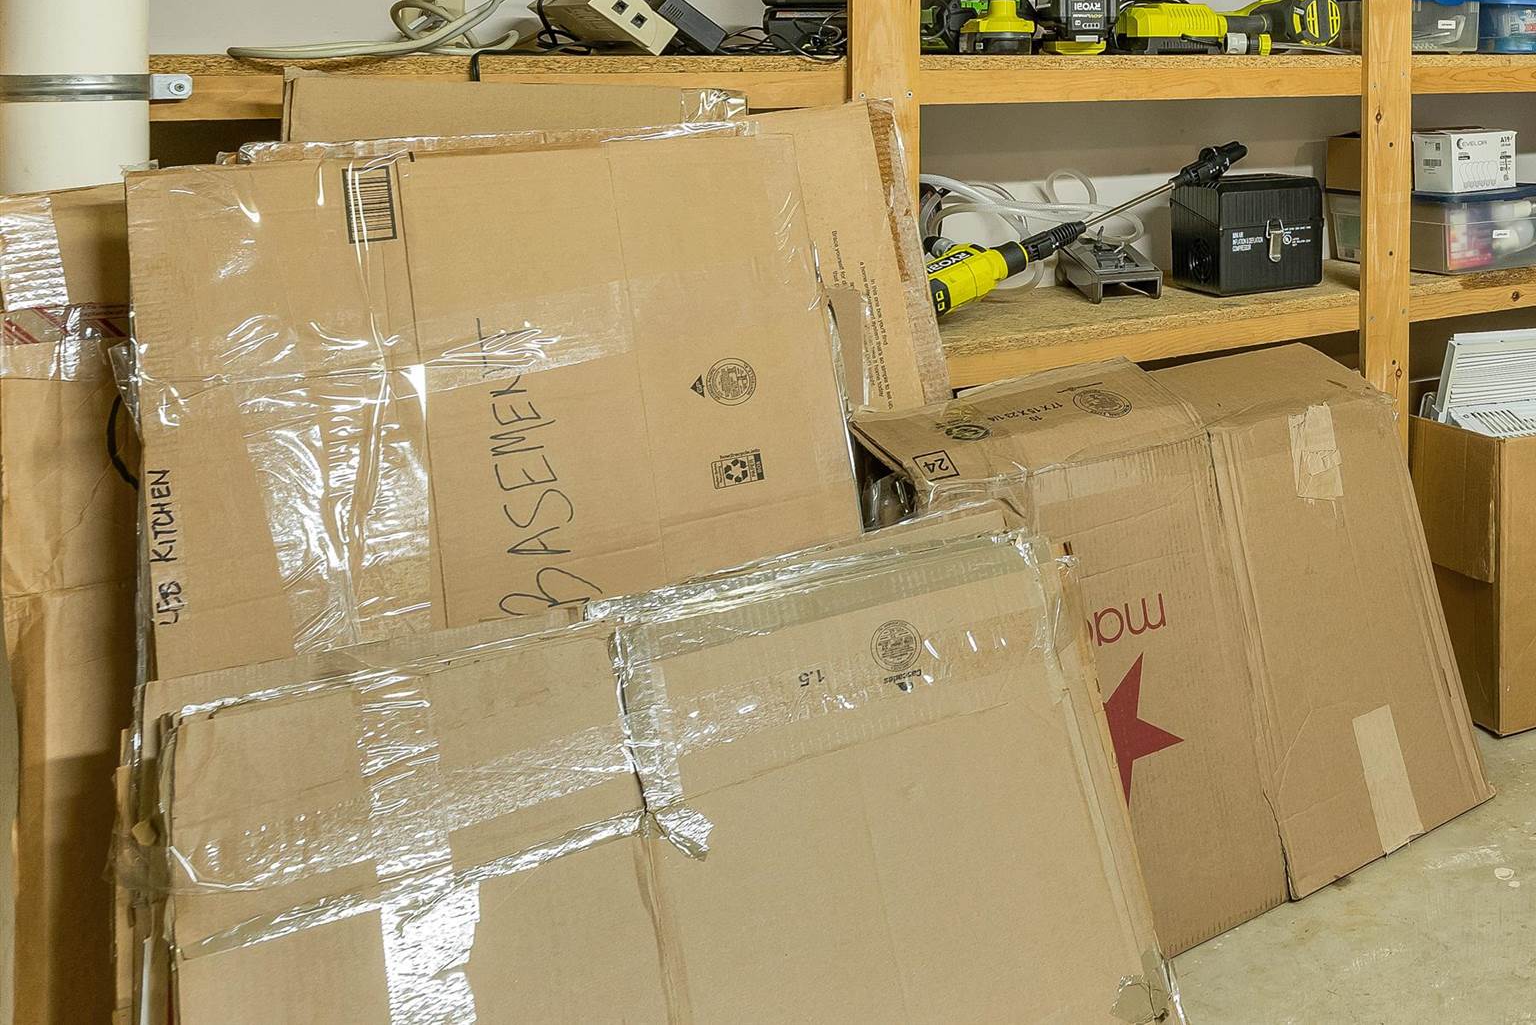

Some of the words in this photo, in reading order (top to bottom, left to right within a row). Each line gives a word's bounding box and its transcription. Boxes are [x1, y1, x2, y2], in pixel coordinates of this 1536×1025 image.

[1074, 2, 1101, 11] RYOBI
[927, 252, 970, 273] RYOBI
[860, 266, 868, 283] home
[871, 321, 880, 340] system
[879, 365, 888, 384] simple
[922, 457, 950, 474] 24
[147, 469, 178, 563] KITCHEN
[799, 669, 825, 687] 1.5
